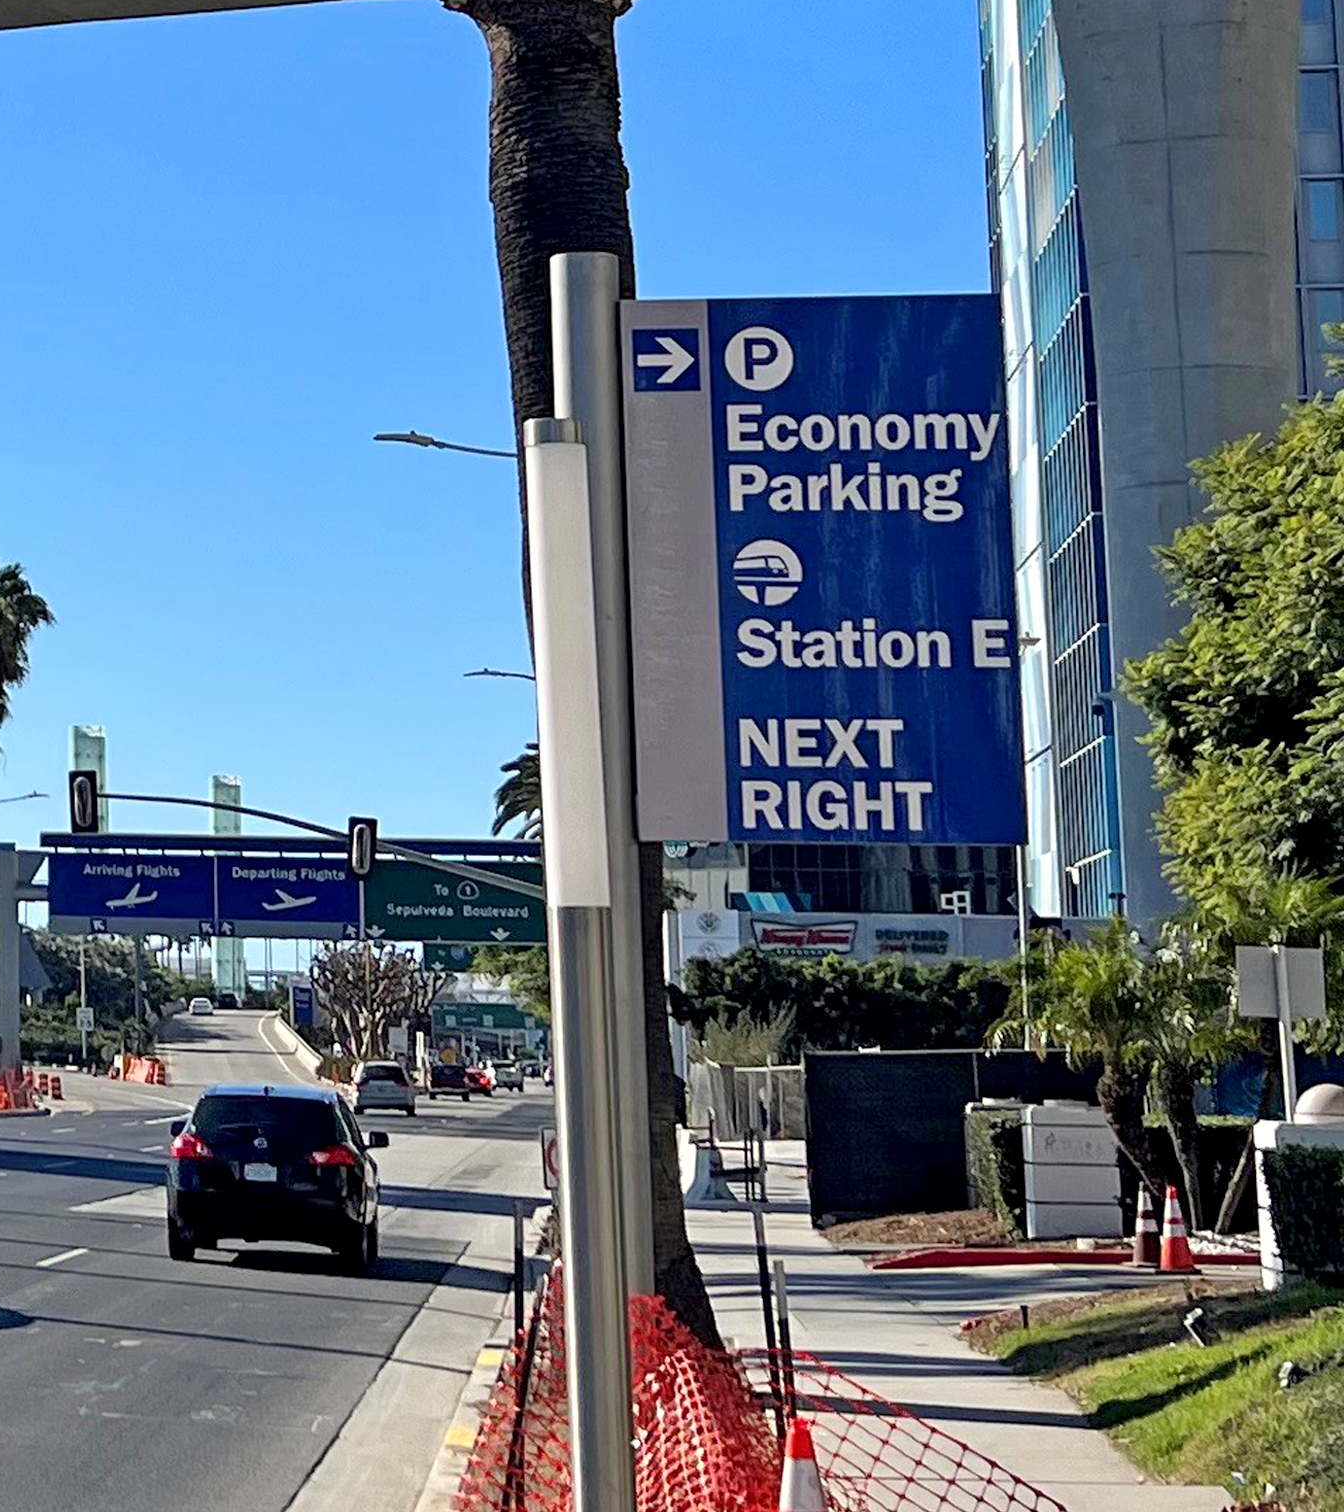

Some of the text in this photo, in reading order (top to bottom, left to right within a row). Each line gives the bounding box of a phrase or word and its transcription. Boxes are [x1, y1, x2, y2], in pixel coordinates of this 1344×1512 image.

[725, 404, 1001, 461] Economy
[728, 462, 964, 523] Parking
[736, 618, 1012, 668] Station E
[738, 718, 904, 768] NEXT
[741, 780, 934, 831] RIGHT
[83, 863, 181, 879] Arriving Flights
[231, 866, 346, 882] Departing Flights
[433, 883, 450, 896] To
[386, 903, 530, 919] Sepulveda Boulevard
